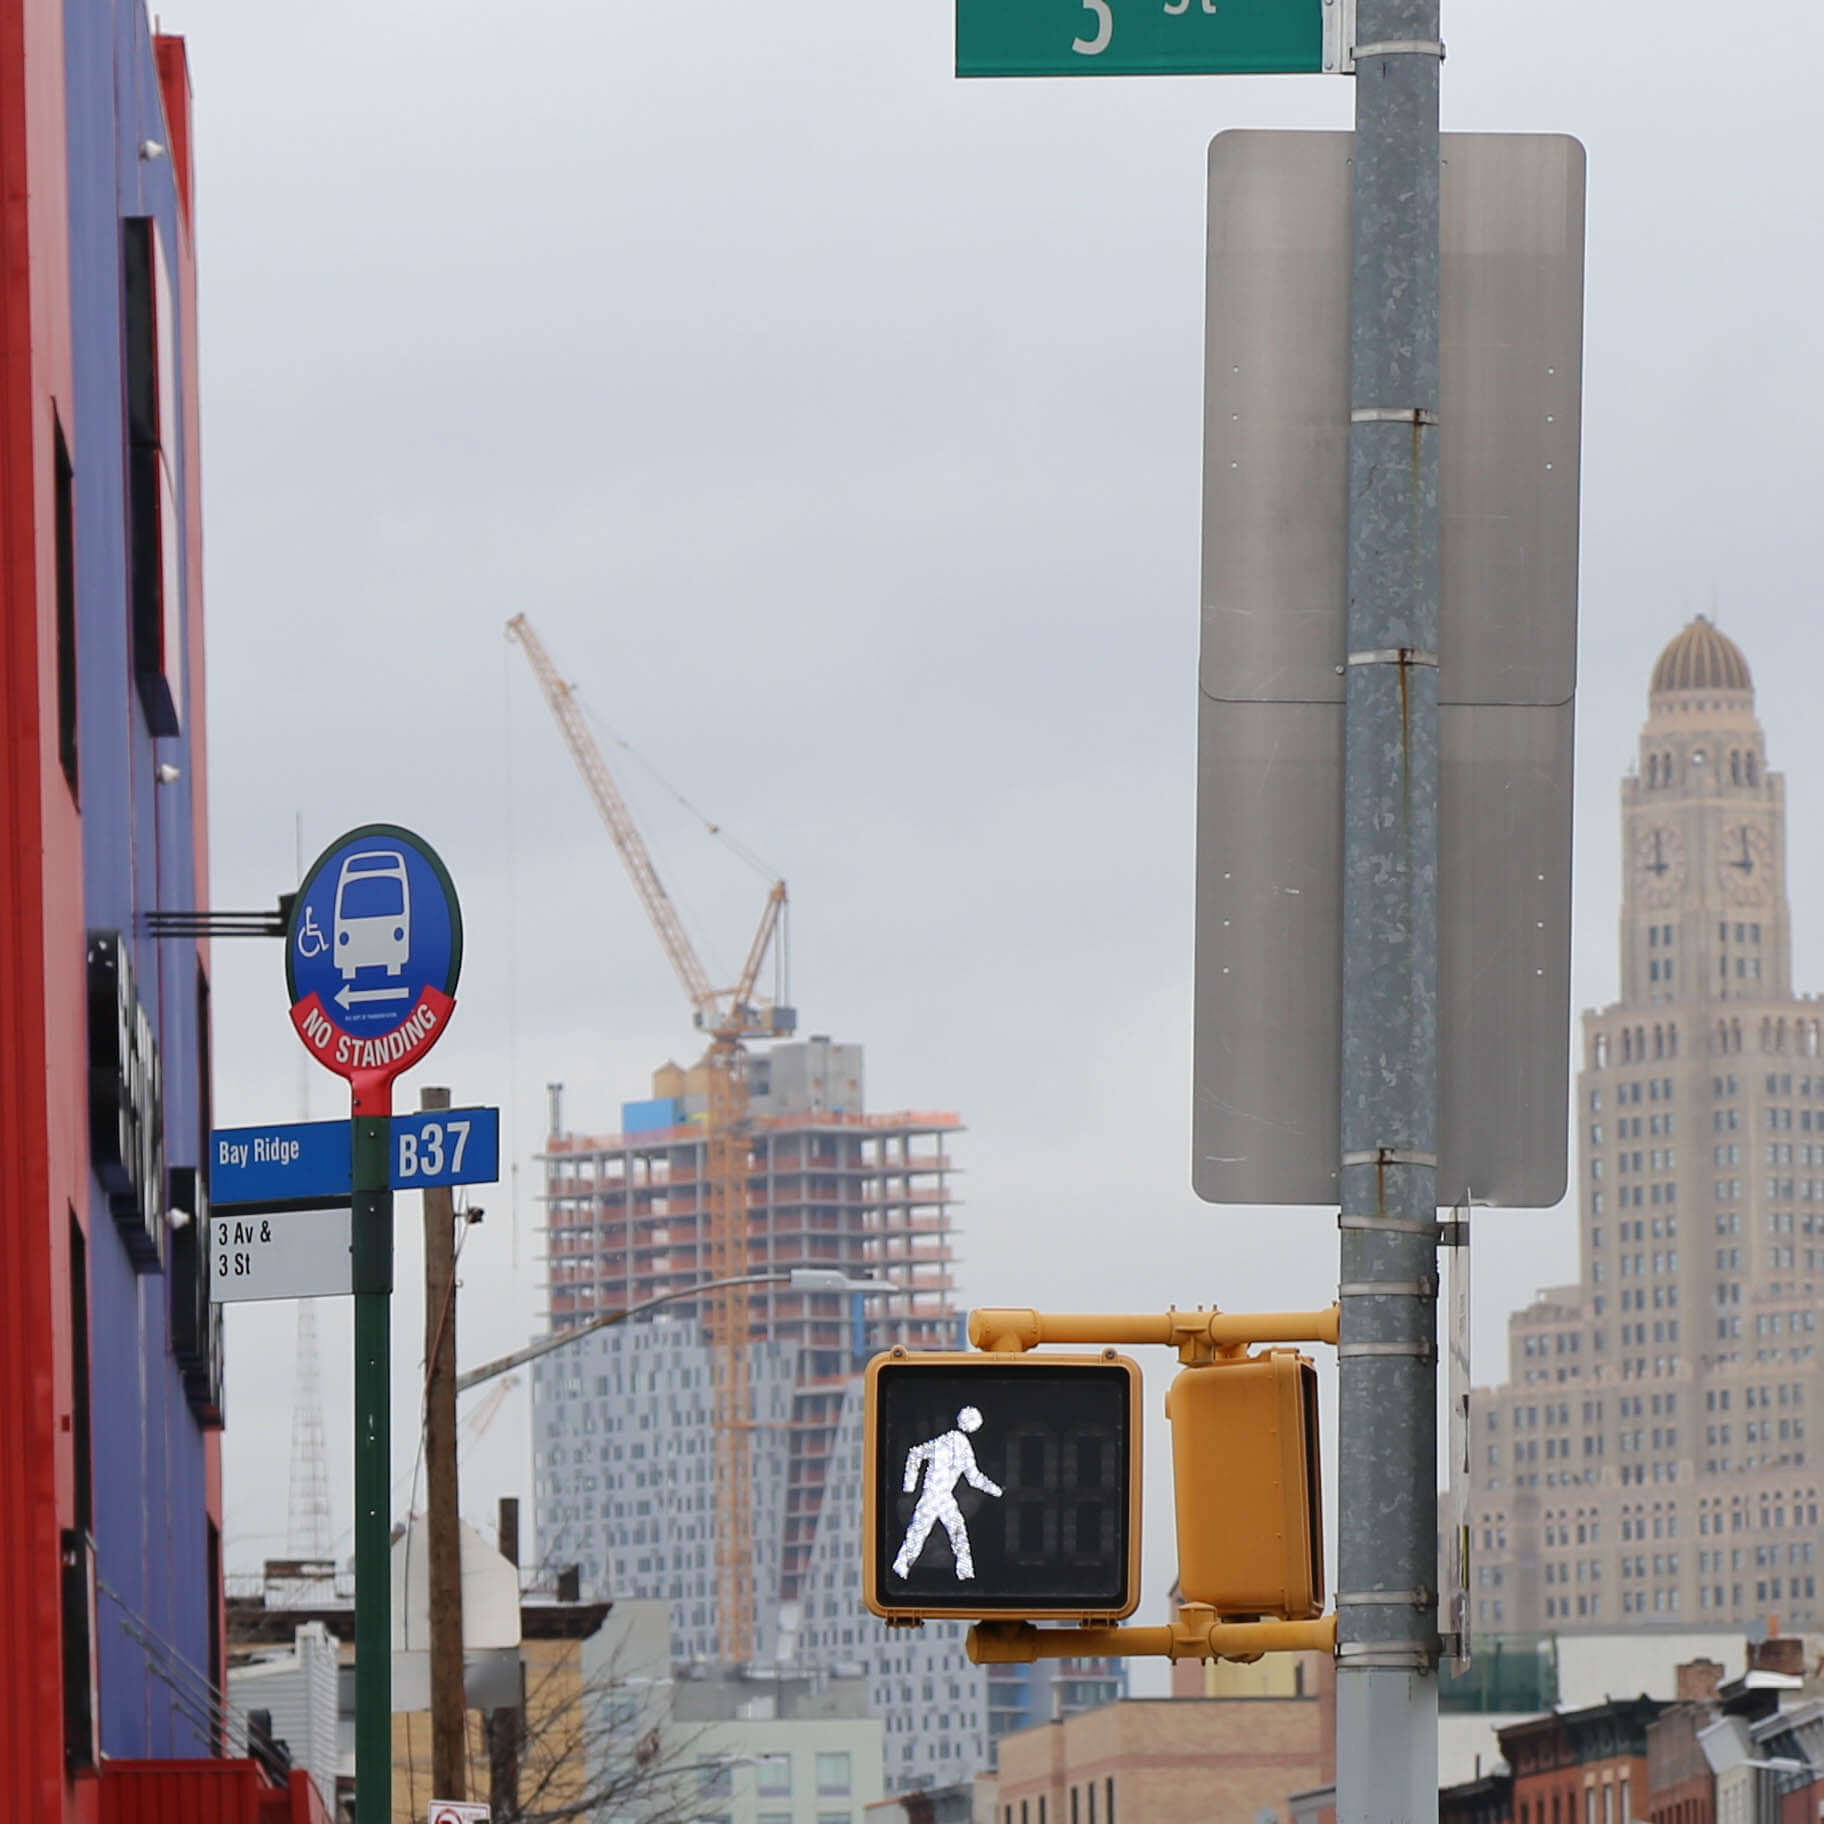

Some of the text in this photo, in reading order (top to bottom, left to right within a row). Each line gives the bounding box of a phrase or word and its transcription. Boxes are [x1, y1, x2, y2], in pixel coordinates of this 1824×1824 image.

[302, 1004, 437, 1066] NO STANDING
[219, 1137, 300, 1168] Bay Ridge
[399, 1121, 471, 1177] B37
[219, 1221, 271, 1245] 3 Av &
[219, 1253, 250, 1276] 3 St
